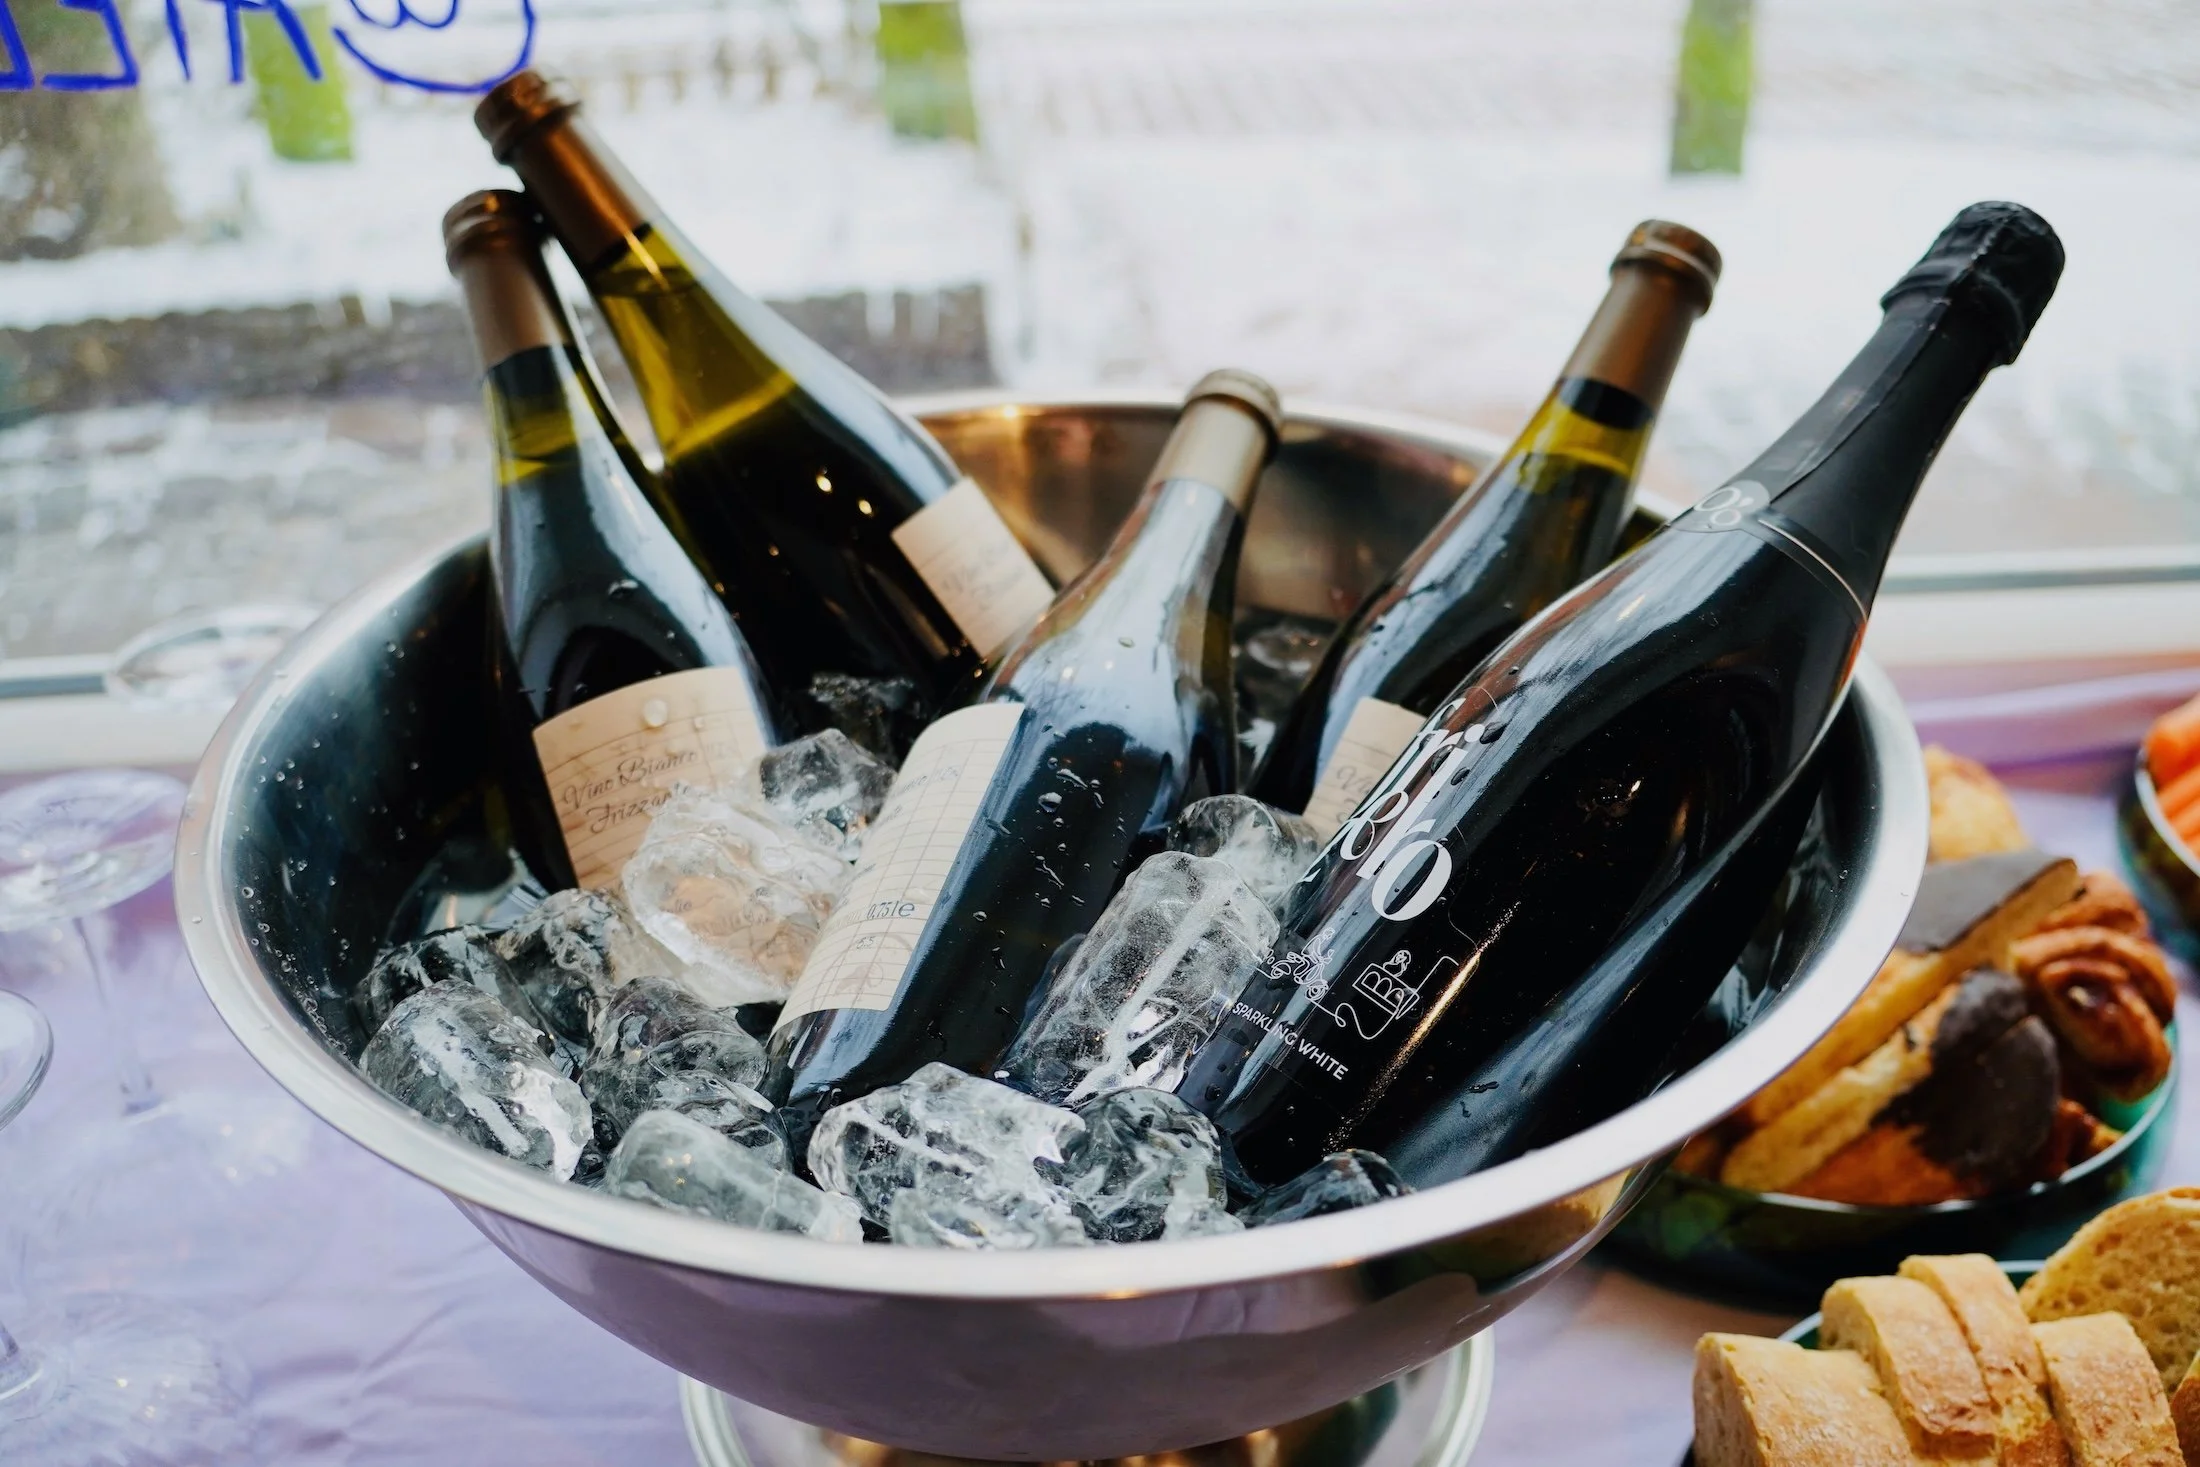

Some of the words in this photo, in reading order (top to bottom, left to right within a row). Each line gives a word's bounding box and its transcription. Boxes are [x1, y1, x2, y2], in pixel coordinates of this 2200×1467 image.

[563, 781, 613, 809] Vino
[1232, 1002, 1298, 1046] SPARKLING
[1298, 1038, 1349, 1080] WHITE
